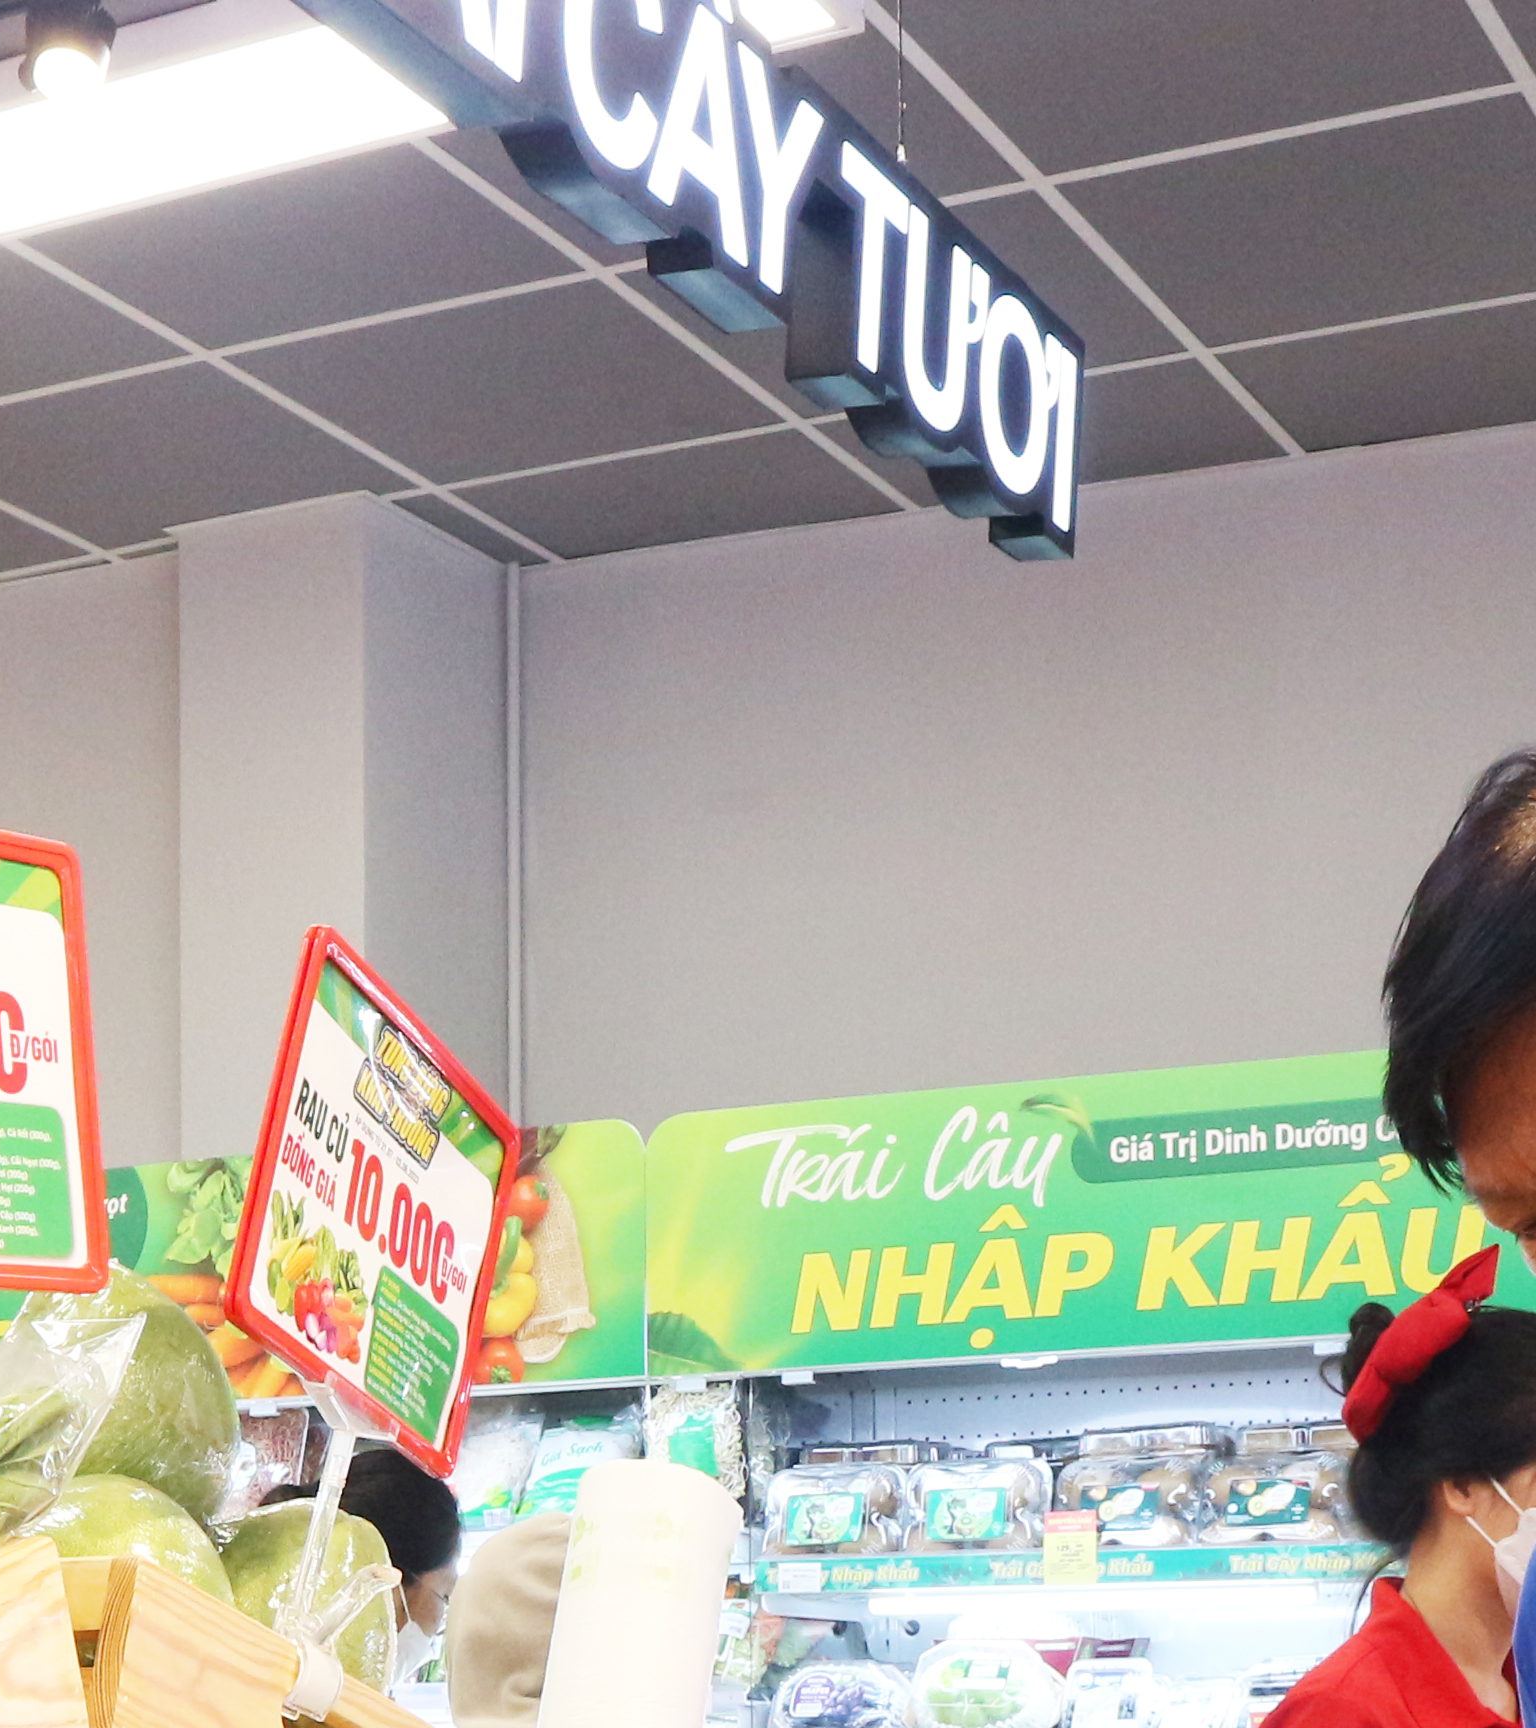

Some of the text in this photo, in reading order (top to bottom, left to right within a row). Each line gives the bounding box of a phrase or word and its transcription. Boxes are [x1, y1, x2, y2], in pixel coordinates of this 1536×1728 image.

[840, 139, 1079, 532] TƯƠI
[9, 1028, 59, 1066] Đ/GÓI
[294, 1077, 351, 1163] RAU CỦ
[724, 1121, 906, 1209] Trái
[923, 1103, 1066, 1207] Cây
[1109, 1132, 1155, 1166] Giá
[1161, 1128, 1199, 1166] Trị
[1205, 1121, 1269, 1157] Dinh
[1274, 1116, 1369, 1159] Dưỡng
[280, 1132, 338, 1213] ĐỒNG GIÁ
[790, 1153, 1487, 1350] NHẬP KHẨU
